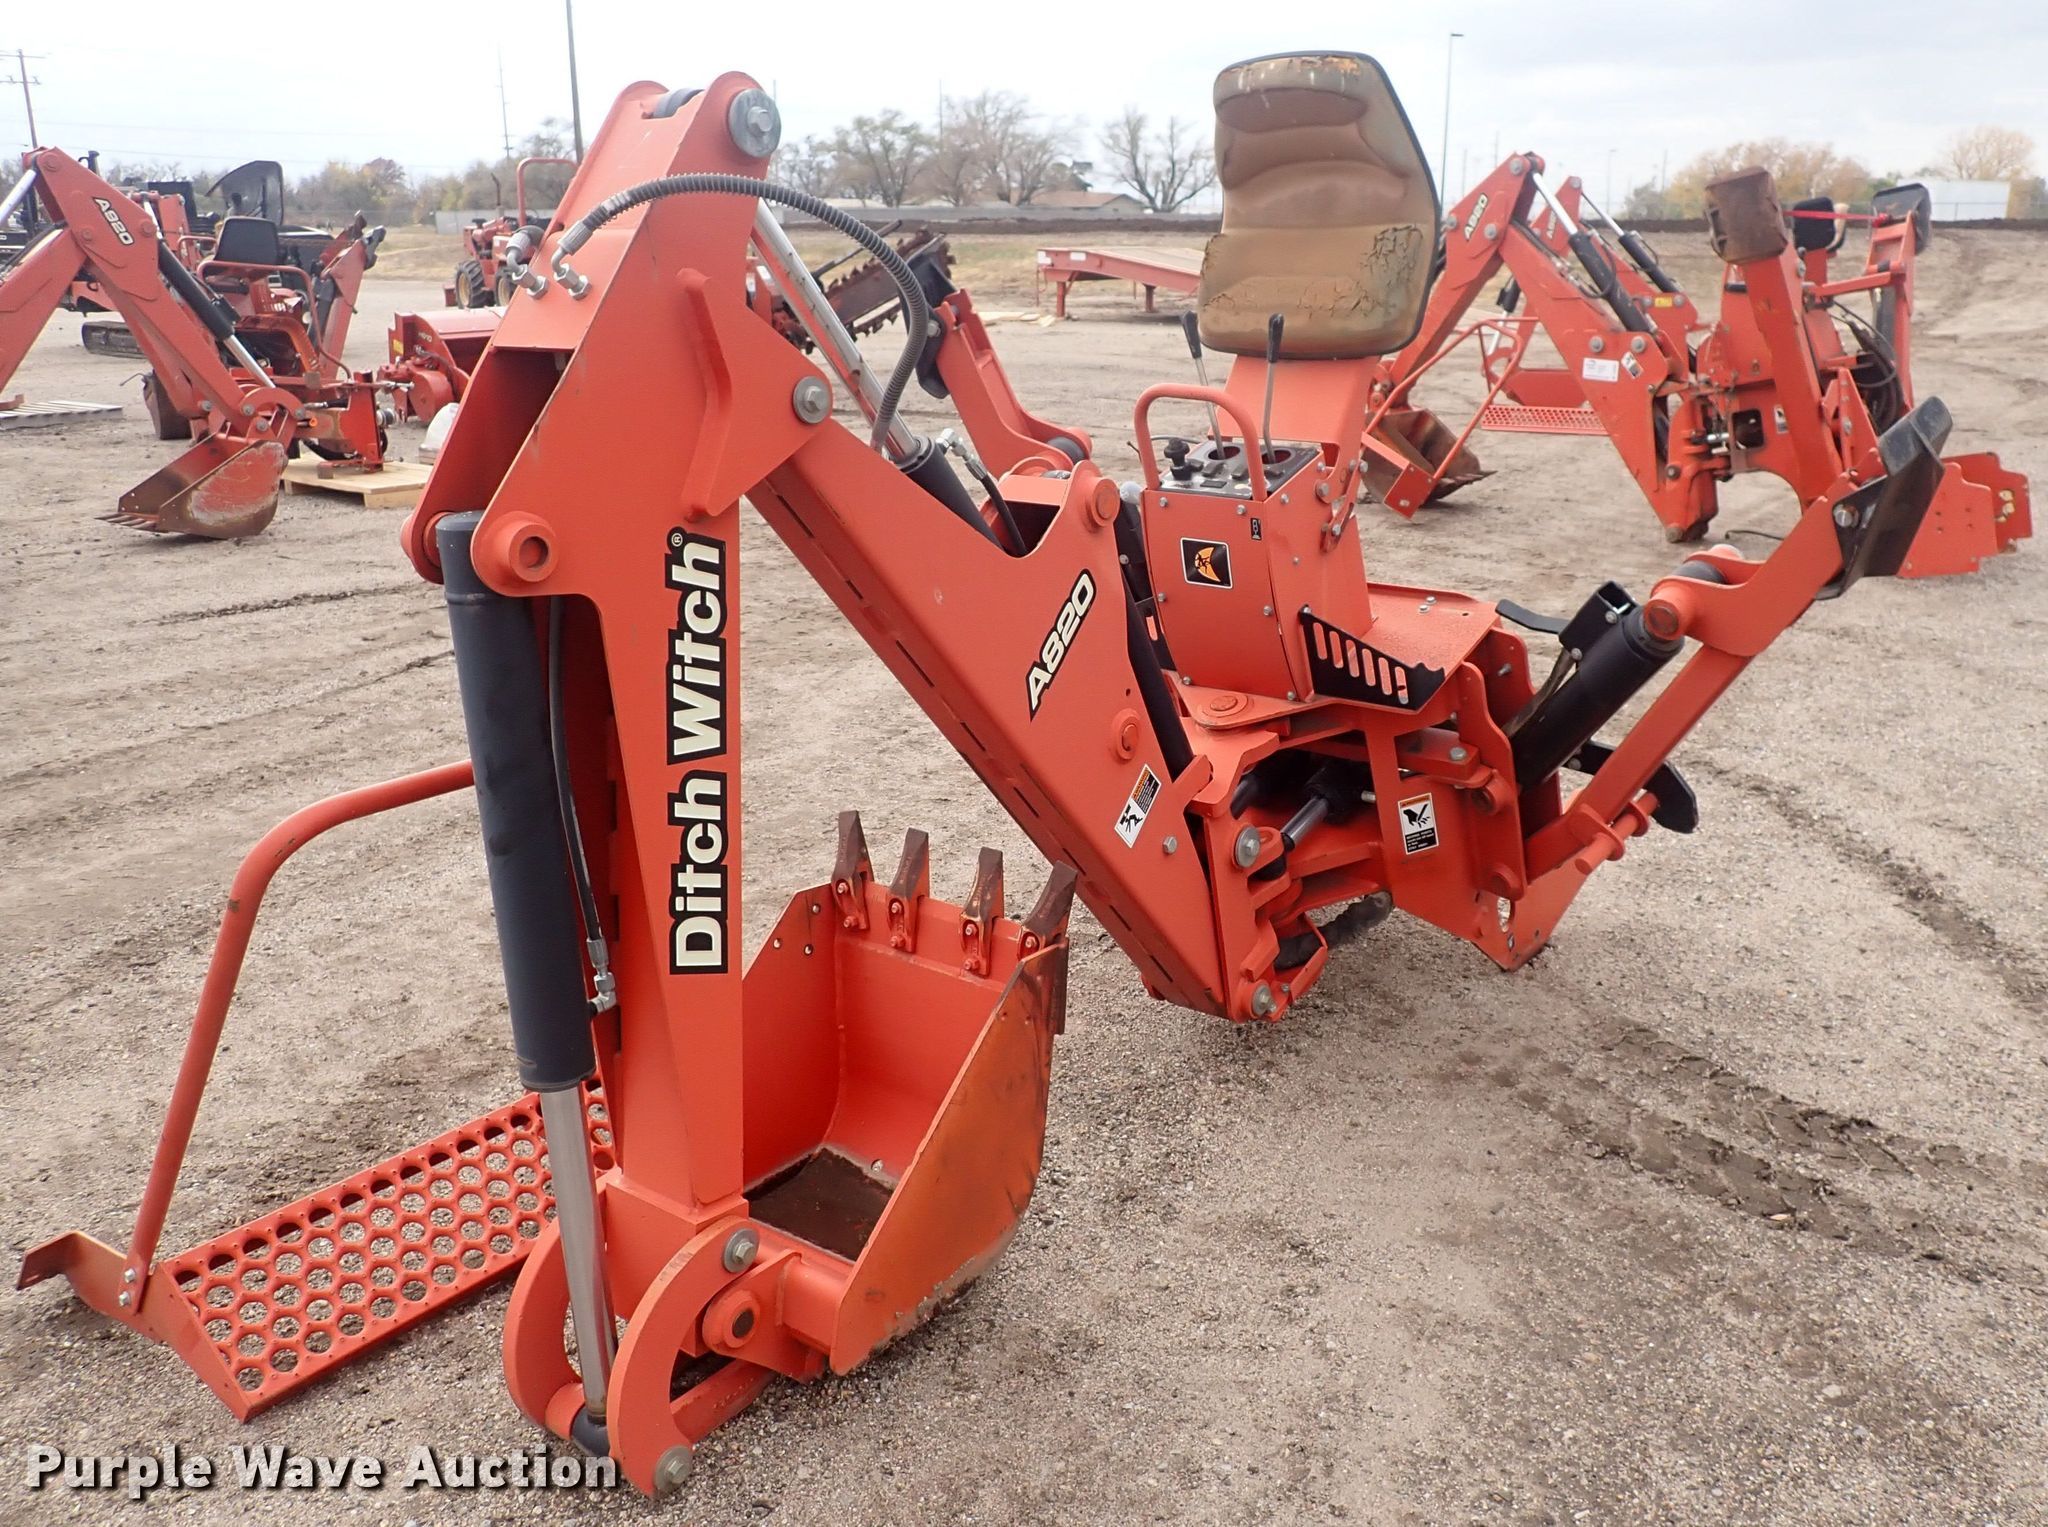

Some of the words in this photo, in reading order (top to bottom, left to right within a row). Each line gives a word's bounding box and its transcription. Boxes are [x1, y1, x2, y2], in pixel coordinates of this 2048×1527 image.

[94, 198, 134, 245] A820
[1028, 572, 1094, 711] A820
[675, 775, 723, 967] Ditch
